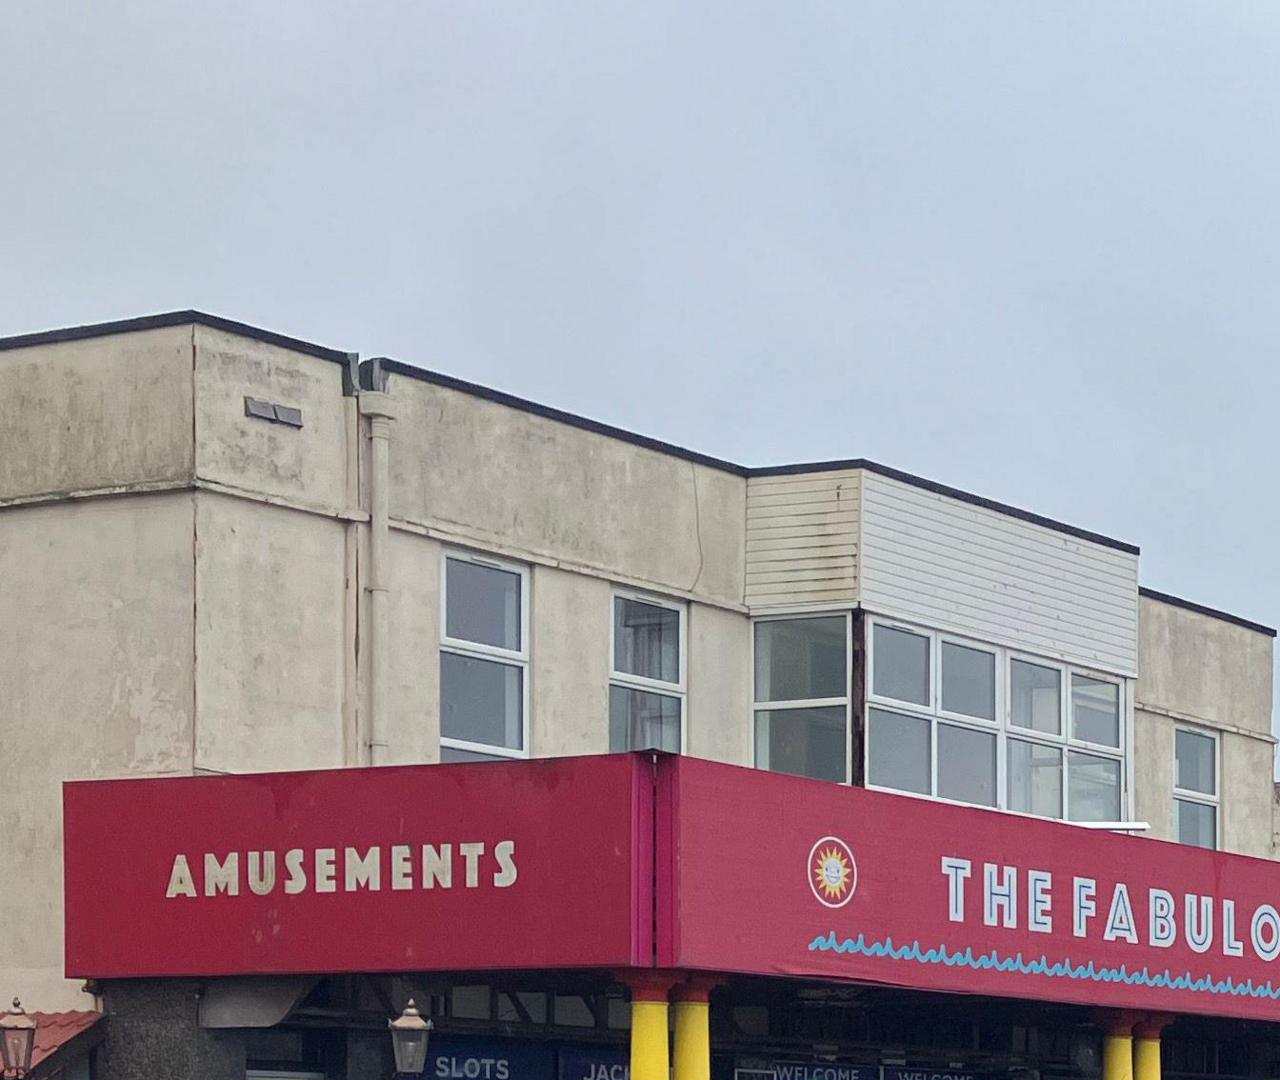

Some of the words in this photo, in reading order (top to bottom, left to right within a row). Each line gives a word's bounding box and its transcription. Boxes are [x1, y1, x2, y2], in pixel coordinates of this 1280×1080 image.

[166, 840, 518, 898] AMUSEMENTS
[941, 856, 1052, 934] THE
[435, 1056, 510, 1080] SLOTS
